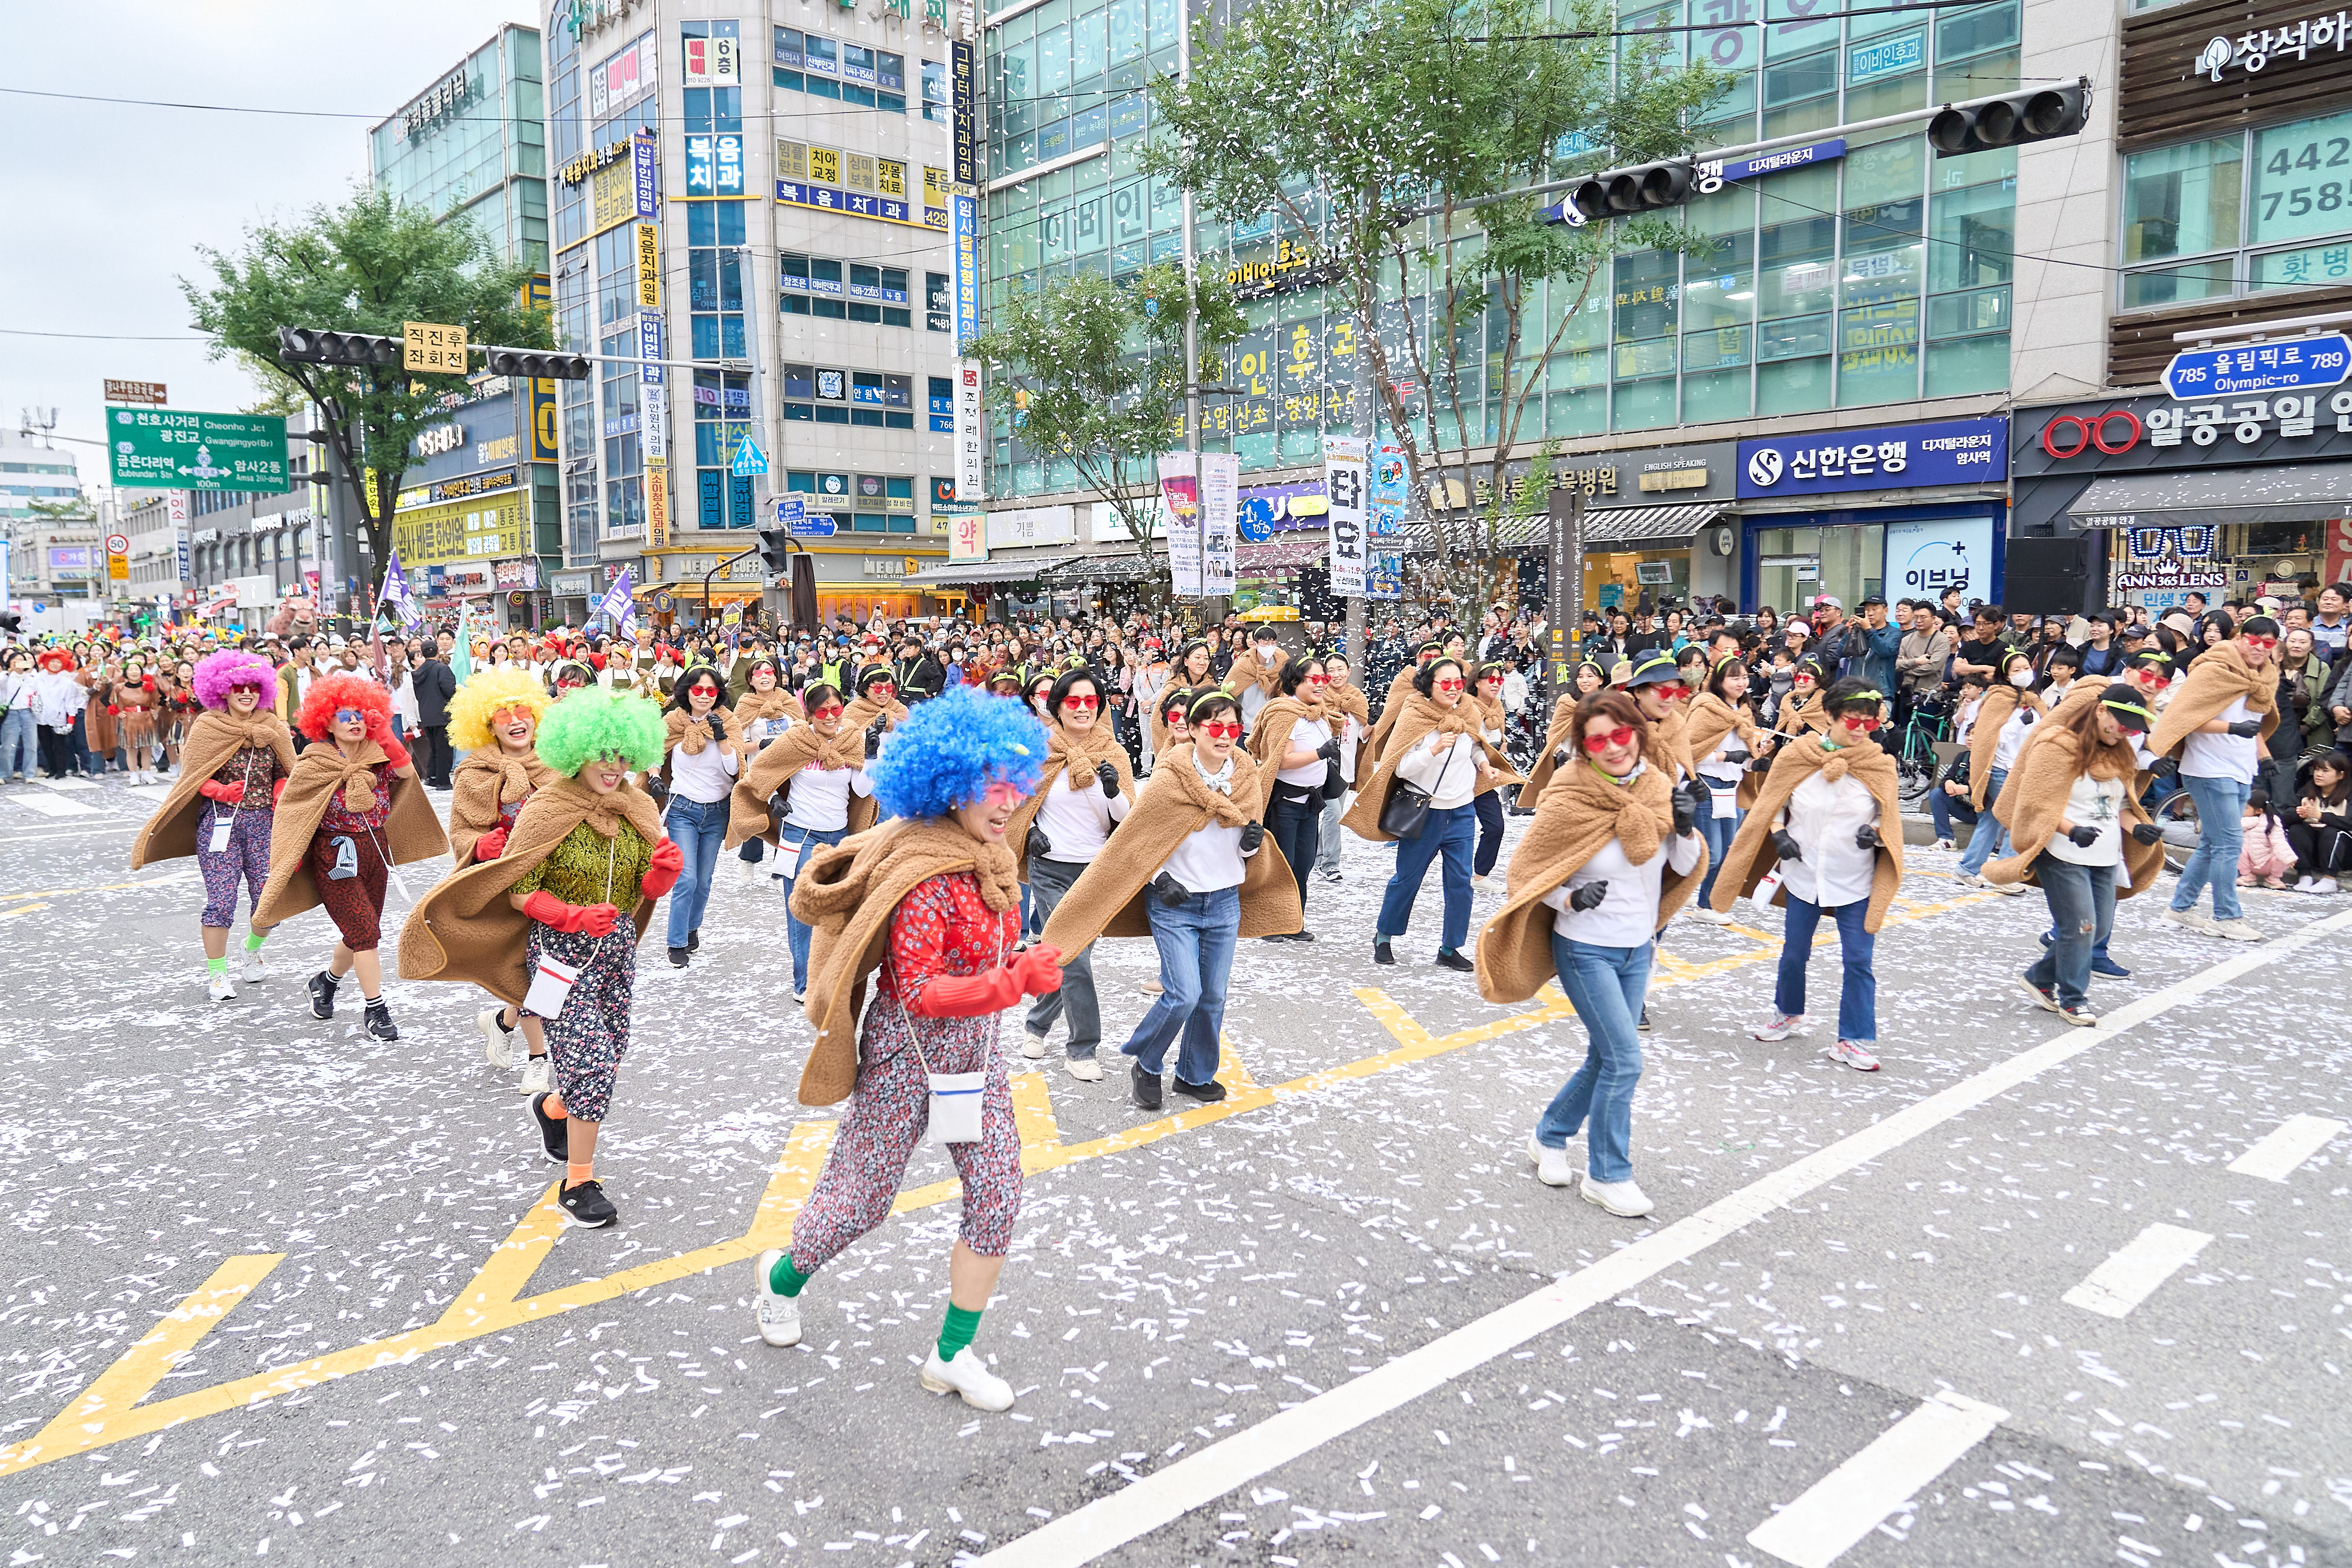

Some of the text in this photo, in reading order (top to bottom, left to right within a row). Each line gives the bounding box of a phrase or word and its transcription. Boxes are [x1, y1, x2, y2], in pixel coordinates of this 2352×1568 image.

[689, 41, 705, 75] 매매
[718, 39, 731, 73] 6층
[777, 51, 800, 62] 여의사
[807, 57, 836, 72] 산부인과
[1859, 39, 1920, 72] 이비인후과
[609, 49, 637, 91] 매매
[845, 65, 874, 81] 441-1566
[956, 46, 972, 180] 그루터기치과의원
[1088, 119, 1106, 133] 녹내장
[565, 142, 613, 184] 복음치과의원
[813, 150, 836, 166] 치아
[850, 156, 871, 173] 심미
[1748, 148, 1813, 173] 디지털라운지
[2266, 136, 2351, 177] 442
[637, 146, 653, 212] 산부인과의원
[812, 166, 836, 182] 교정
[878, 162, 901, 178] 잇몸
[850, 172, 873, 189] 보철
[878, 179, 901, 194] 치료
[639, 225, 657, 305] 복음치과의원
[784, 276, 807, 289] 참조은
[812, 280, 841, 293] 이비인후과
[851, 285, 879, 298] 481-2203
[641, 314, 660, 323] 참조은
[409, 328, 463, 347] 직진후
[409, 349, 462, 369] 좌회전
[643, 323, 662, 378] 이비인과
[2176, 346, 2344, 384] 785 올림픽로 789
[2214, 373, 2300, 392] Olympic-ro
[119, 412, 265, 433] 50 천호사거리 Cheonho Jct
[649, 403, 662, 456] 안원식의원
[2146, 395, 2316, 447] 일공공일
[159, 430, 273, 449] 광진교 Gwangjingyo(Br)
[116, 454, 175, 469] 굽은다리역
[234, 460, 281, 474] 암사2동
[1644, 459, 1706, 472] ENGLISH SPEAKING
[1789, 434, 1992, 480] 신한은행 디지털라운지
[1956, 450, 1991, 466] 암사역
[160, 470, 173, 479] Stn
[236, 473, 255, 482] Amsa
[196, 480, 220, 489] 100m
[702, 472, 721, 525] 예방접종
[734, 476, 751, 524] 유아검진
[821, 496, 845, 504] 알레르기
[651, 474, 664, 546] 소아청소년과의원
[1331, 470, 1362, 559] 타요
[936, 522, 948, 530] 47
[2086, 515, 2136, 527] 일공공일 안경
[110, 540, 124, 549] 50
[958, 519, 977, 554] 약
[1554, 518, 1563, 566] 한강공원
[680, 559, 716, 574] MEGA
[864, 560, 904, 574] MEGA
[2237, 570, 2246, 579] A
[1905, 567, 1970, 592] 이브닝
[2117, 573, 2225, 590] ANN 365 LENS
[2143, 591, 2174, 607] 민생
